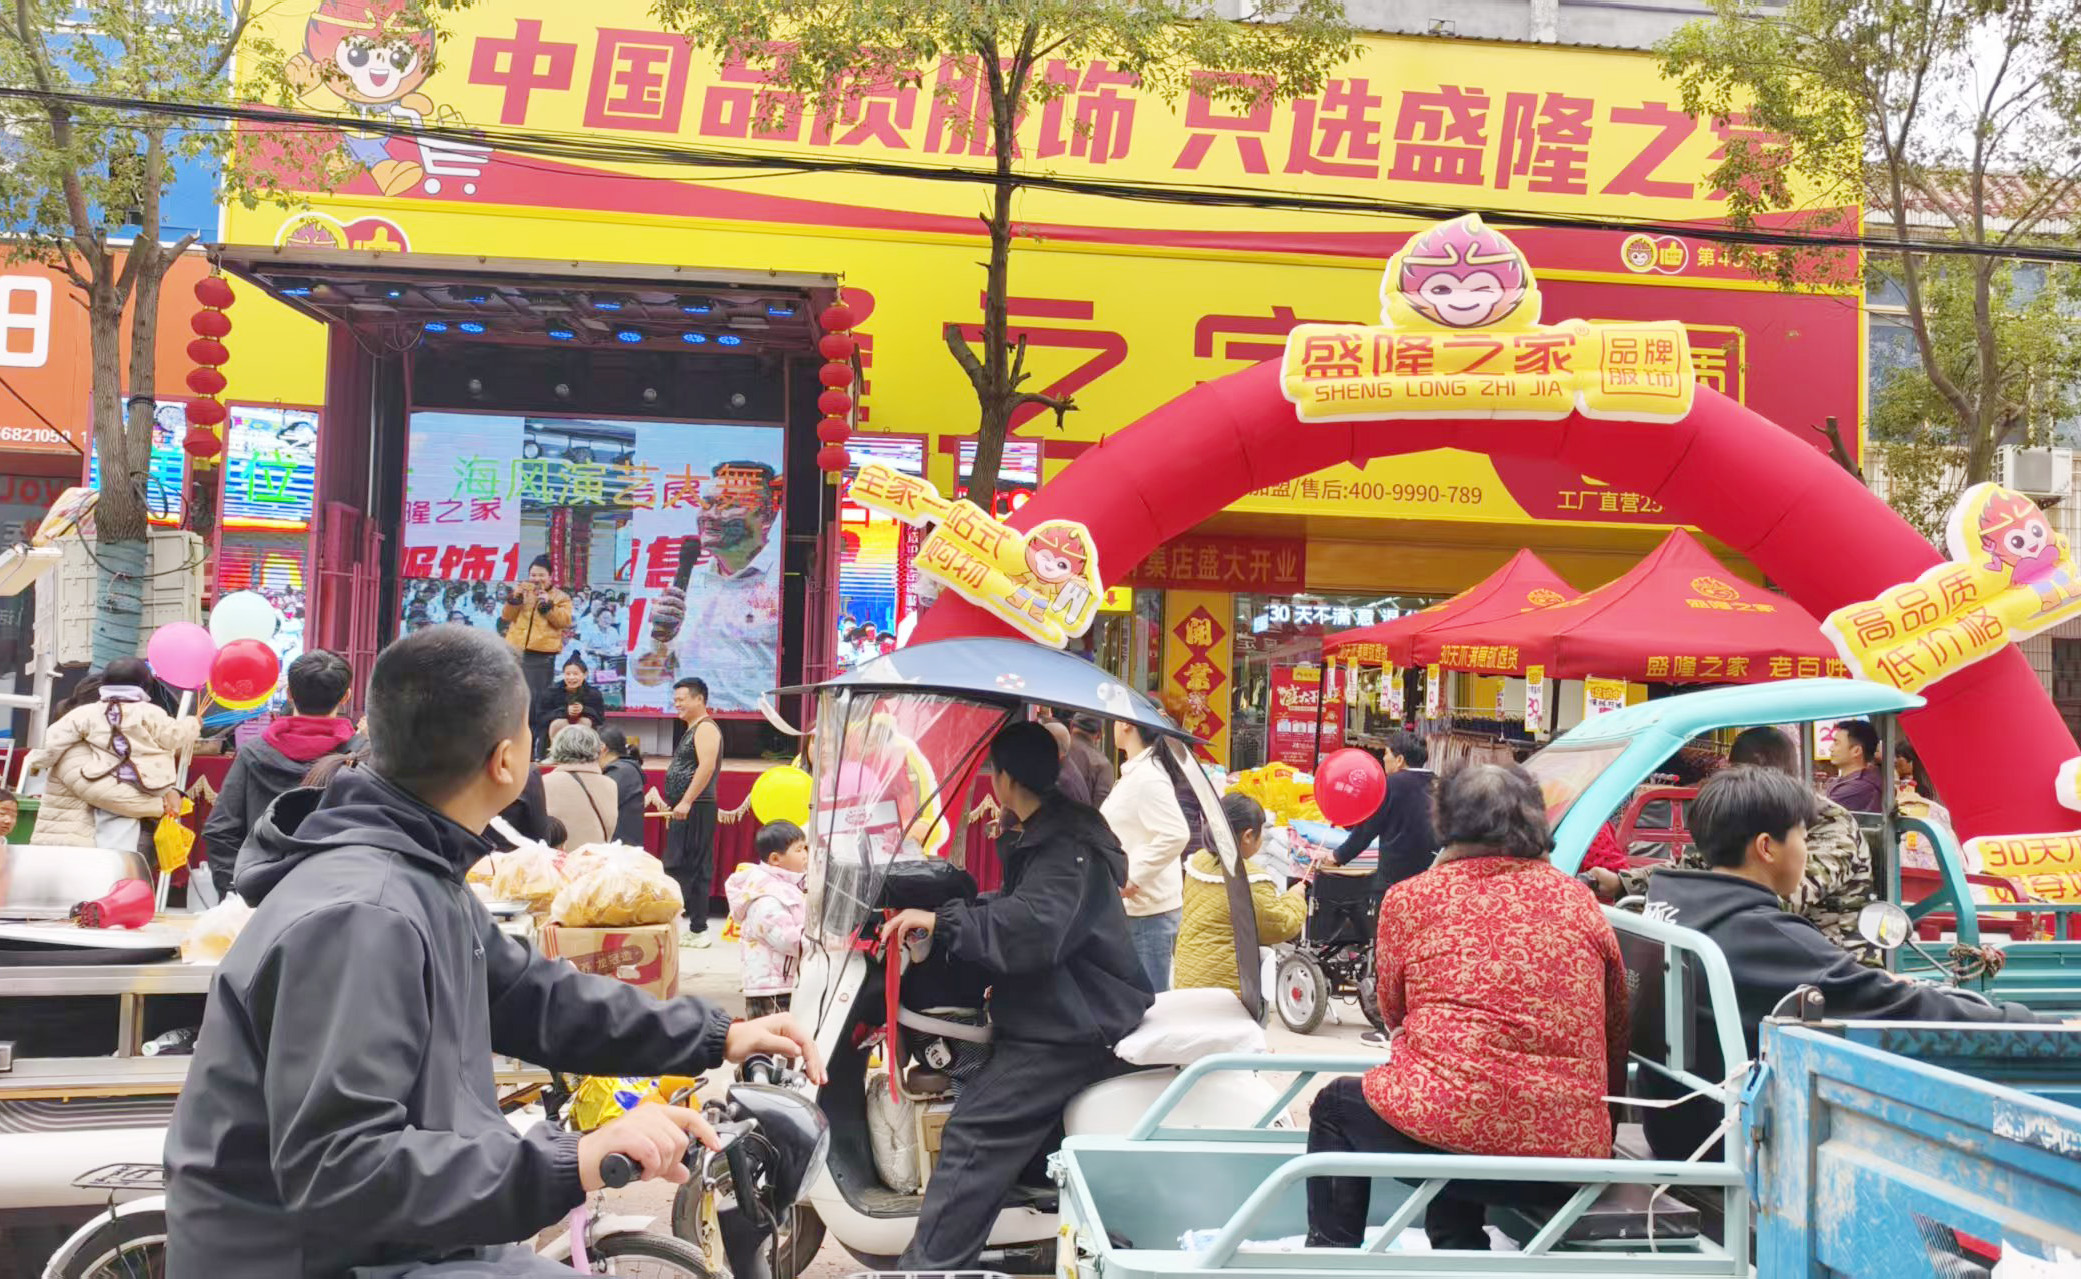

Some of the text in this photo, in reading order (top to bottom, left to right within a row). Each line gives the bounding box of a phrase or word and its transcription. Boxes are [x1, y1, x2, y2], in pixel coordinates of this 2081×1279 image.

[1301, 333, 1575, 382] 盛隆之家
[1609, 338, 1673, 366] 品牌
[1315, 380, 1563, 402] SHENG LONG ZHI JIA
[1608, 370, 1674, 389] 服饰
[240, 447, 299, 502] 位
[855, 465, 1011, 560] 全家一站式
[924, 535, 991, 590] 购物
[1846, 568, 1978, 649] 高品质
[1646, 655, 1847, 678] 盛隆之家 老百姓
[1877, 606, 2005, 689] 低价格
